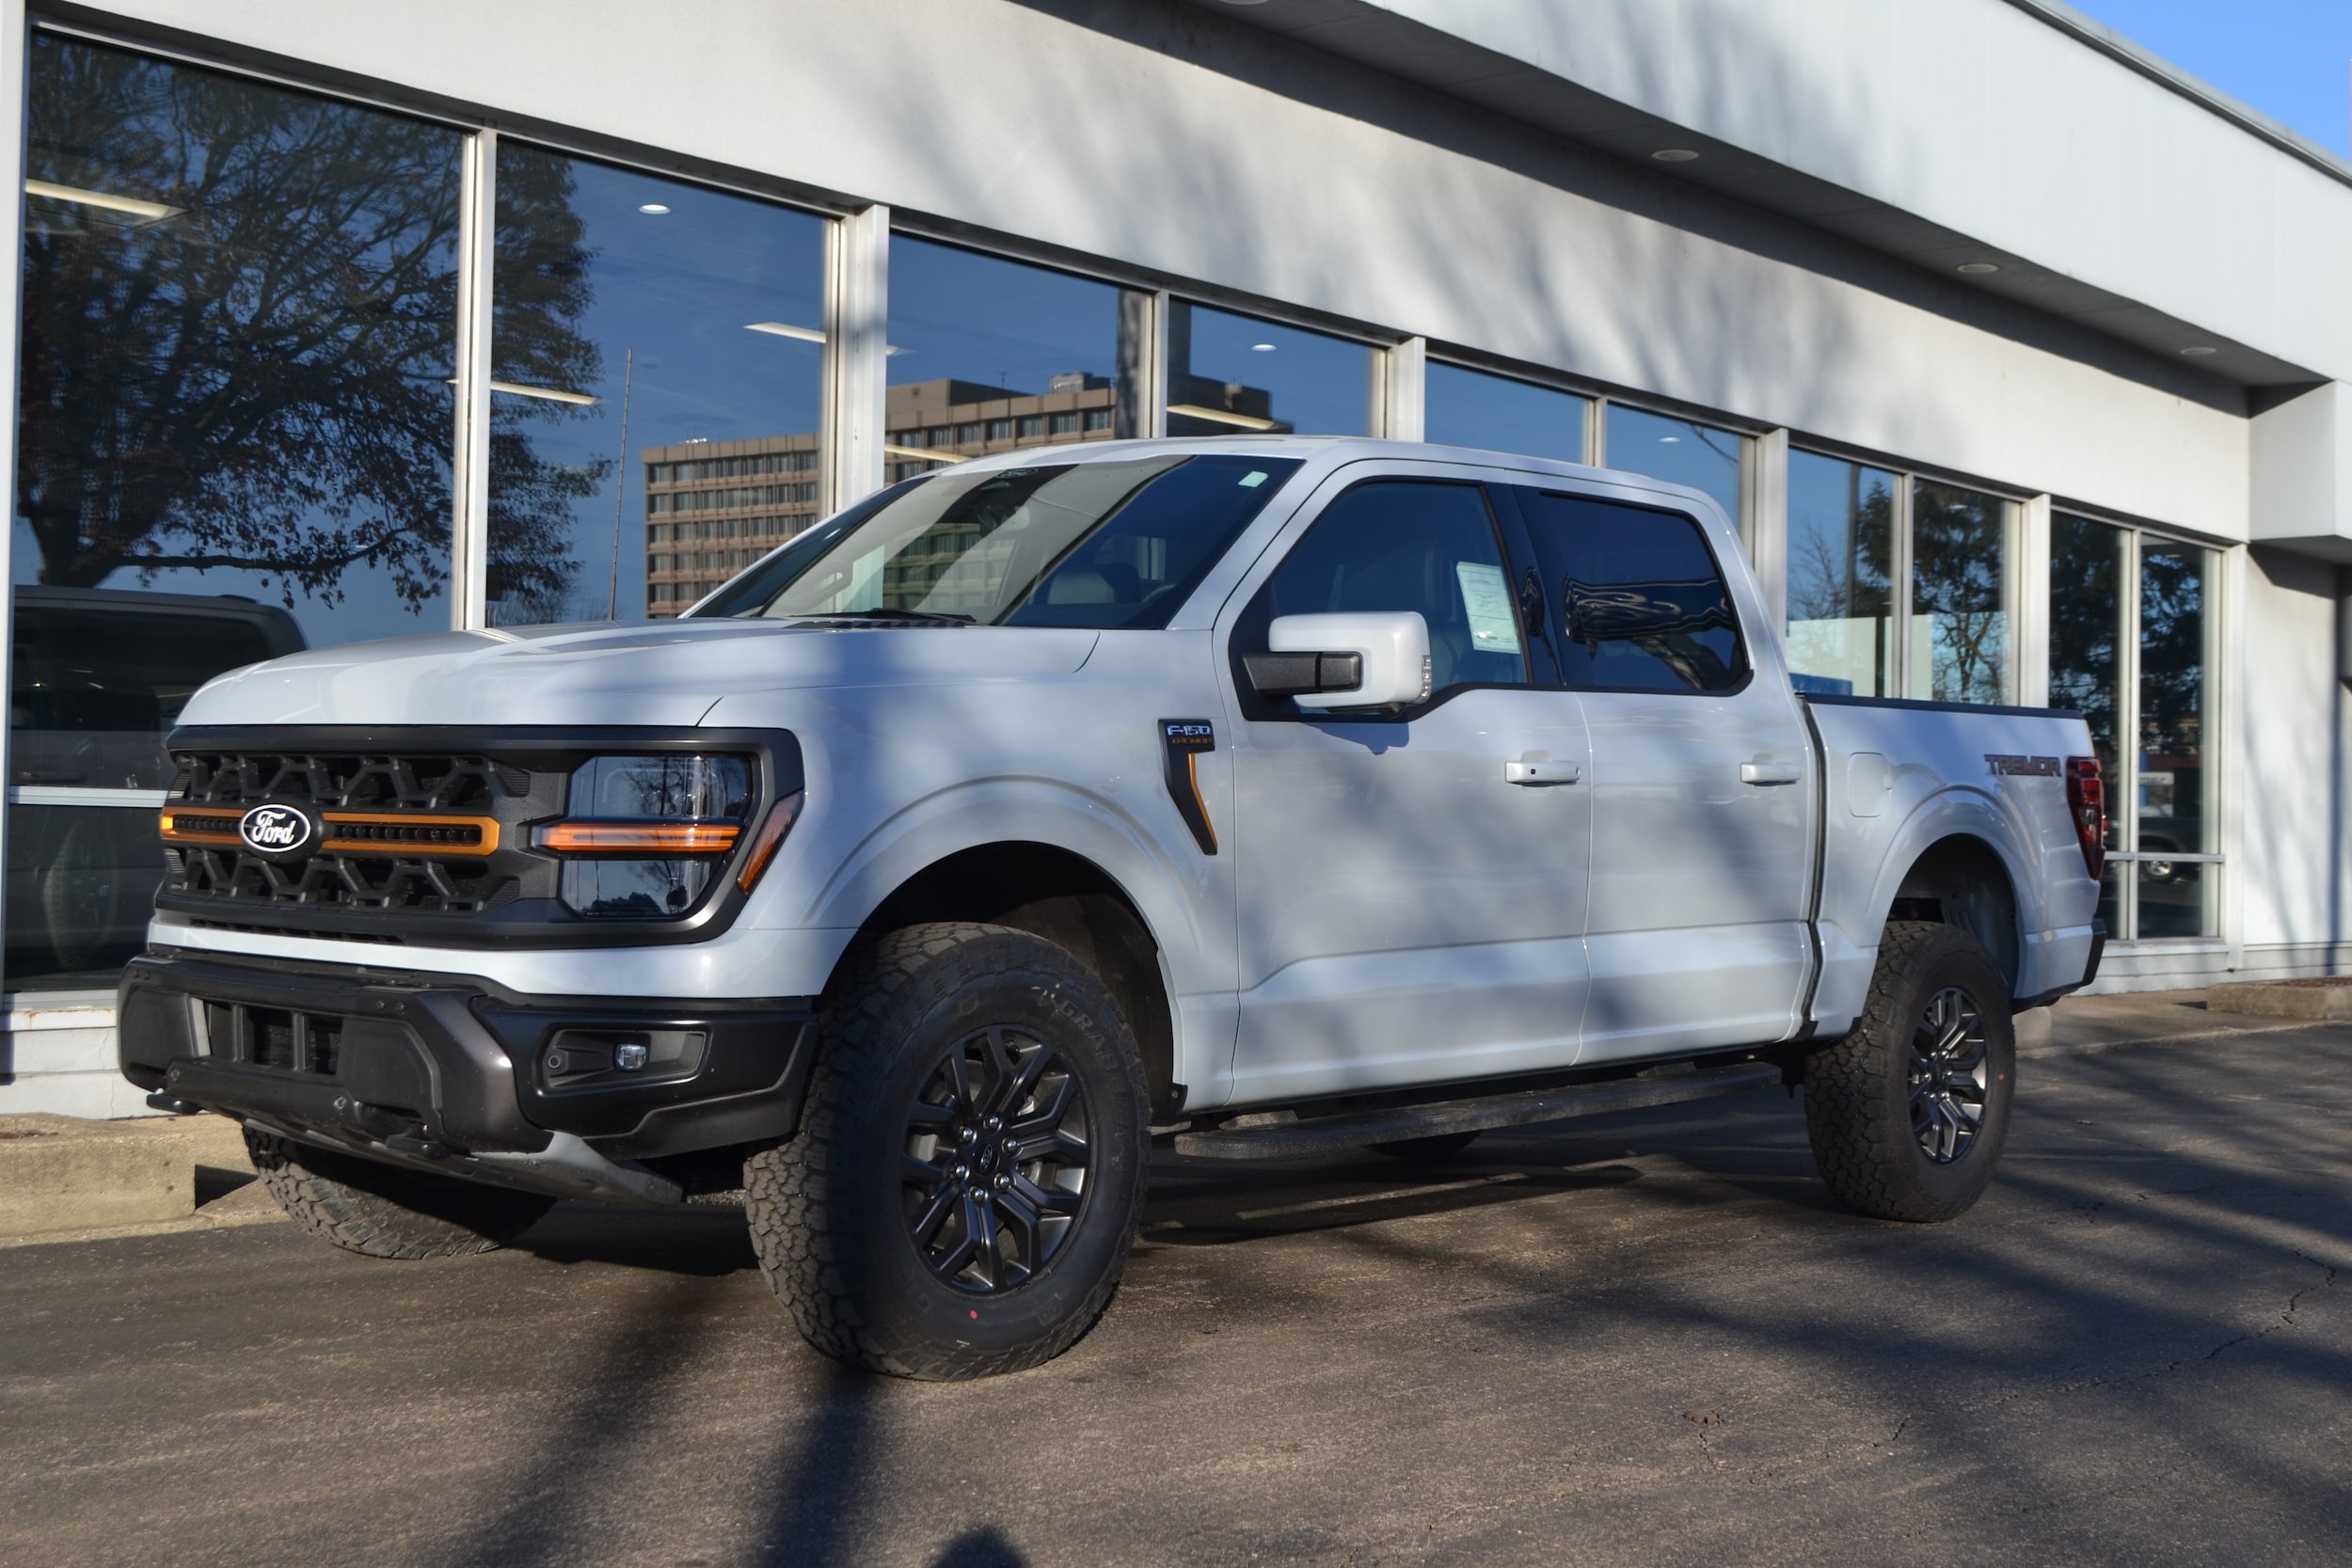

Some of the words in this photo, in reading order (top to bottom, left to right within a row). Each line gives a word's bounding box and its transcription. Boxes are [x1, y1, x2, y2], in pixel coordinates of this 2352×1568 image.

[1167, 725, 1212, 736] F-150
[1984, 754, 2062, 777] TREMOR
[252, 811, 296, 844] Ford
